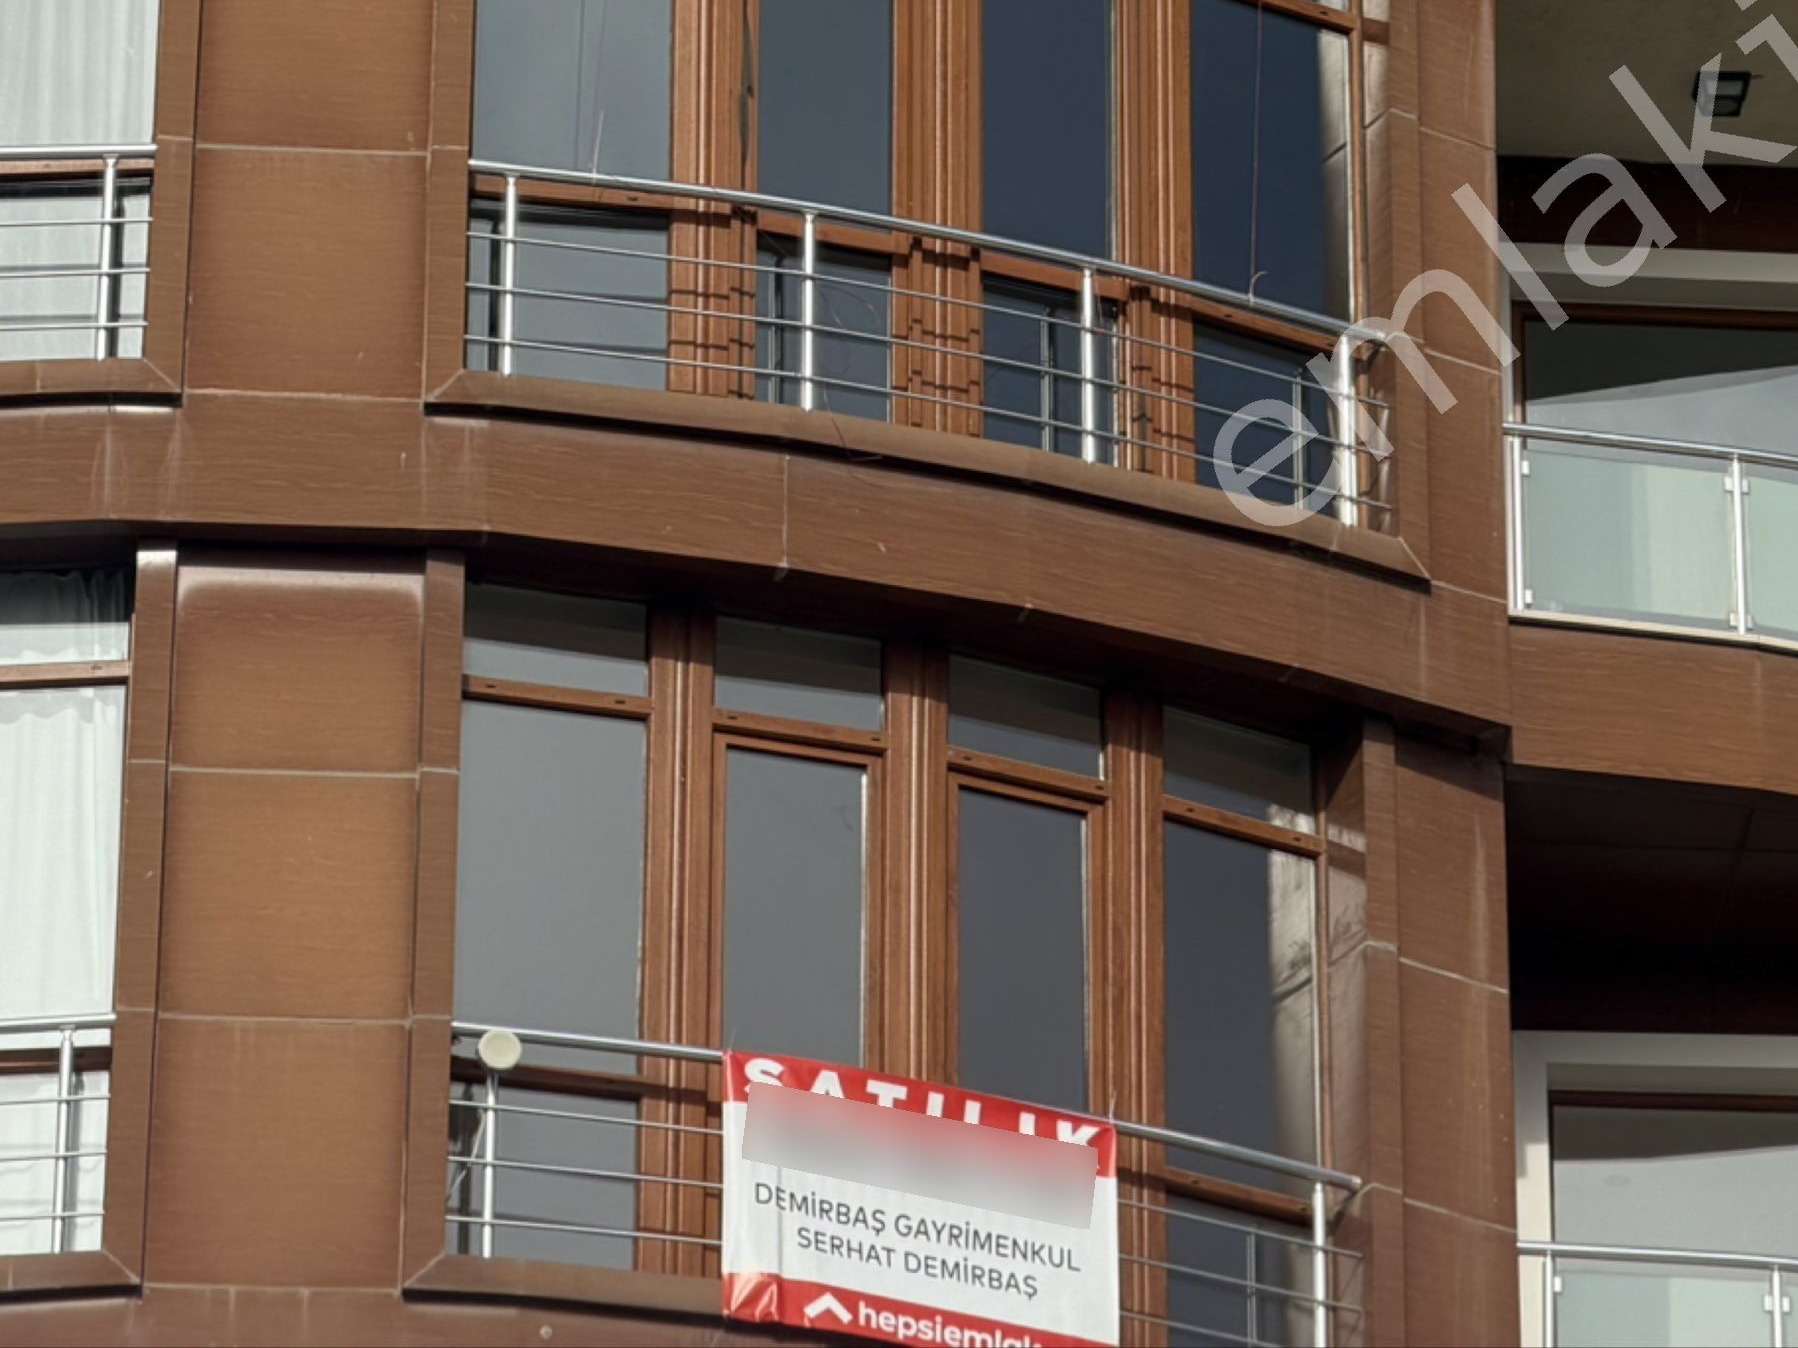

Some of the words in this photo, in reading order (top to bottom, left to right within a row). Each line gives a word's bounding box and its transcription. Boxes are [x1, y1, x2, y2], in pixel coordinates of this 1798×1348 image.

[754, 1182, 885, 1236] DEMİRBAŞ
[894, 1213, 1081, 1272] GAYRİMENKUL
[798, 1227, 895, 1268] SERHAT
[904, 1251, 1038, 1300] DEMİRBAŞ
